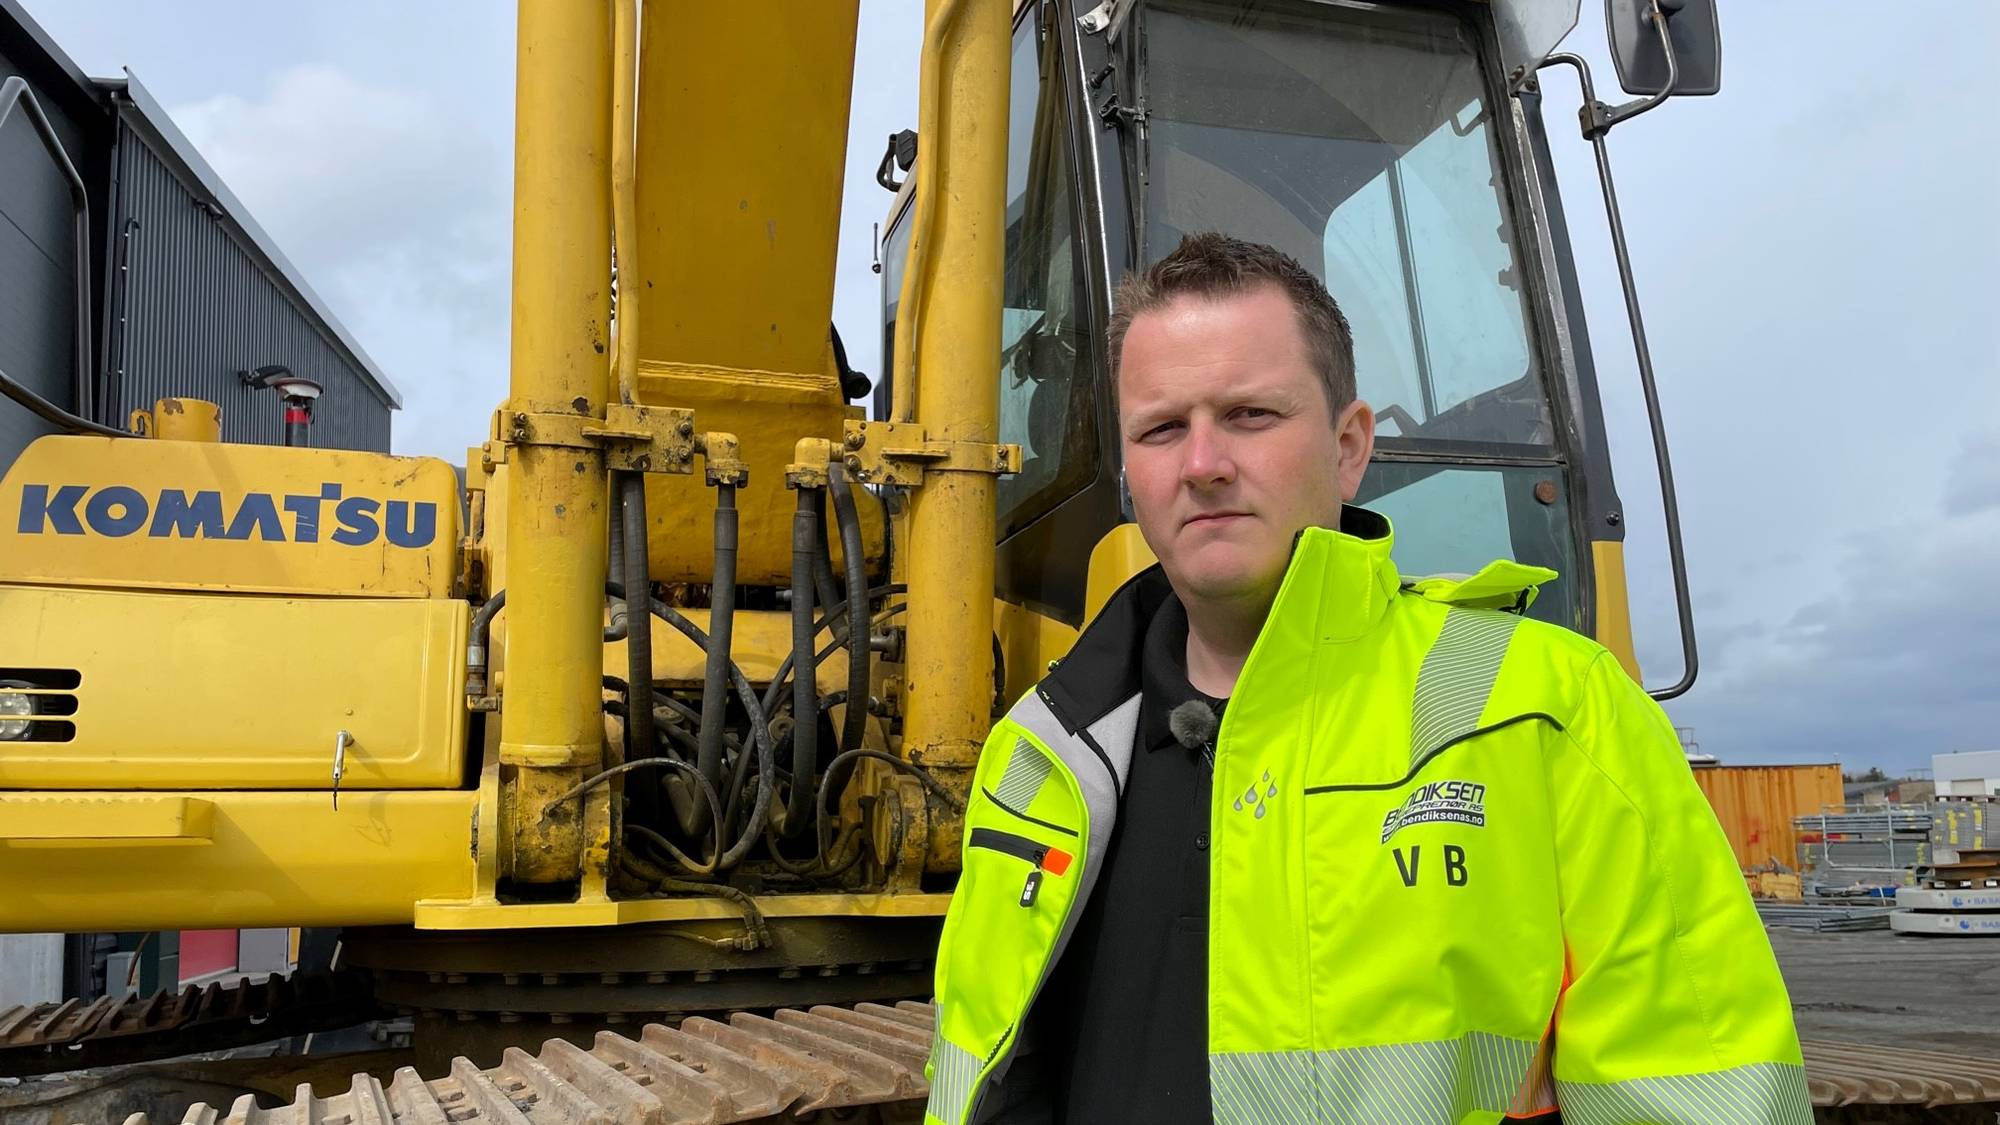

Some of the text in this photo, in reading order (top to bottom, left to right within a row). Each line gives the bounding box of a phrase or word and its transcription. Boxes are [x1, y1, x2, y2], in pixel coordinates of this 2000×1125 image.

[17, 483, 437, 548] KOMATSU
[1392, 844, 1468, 887] V B
